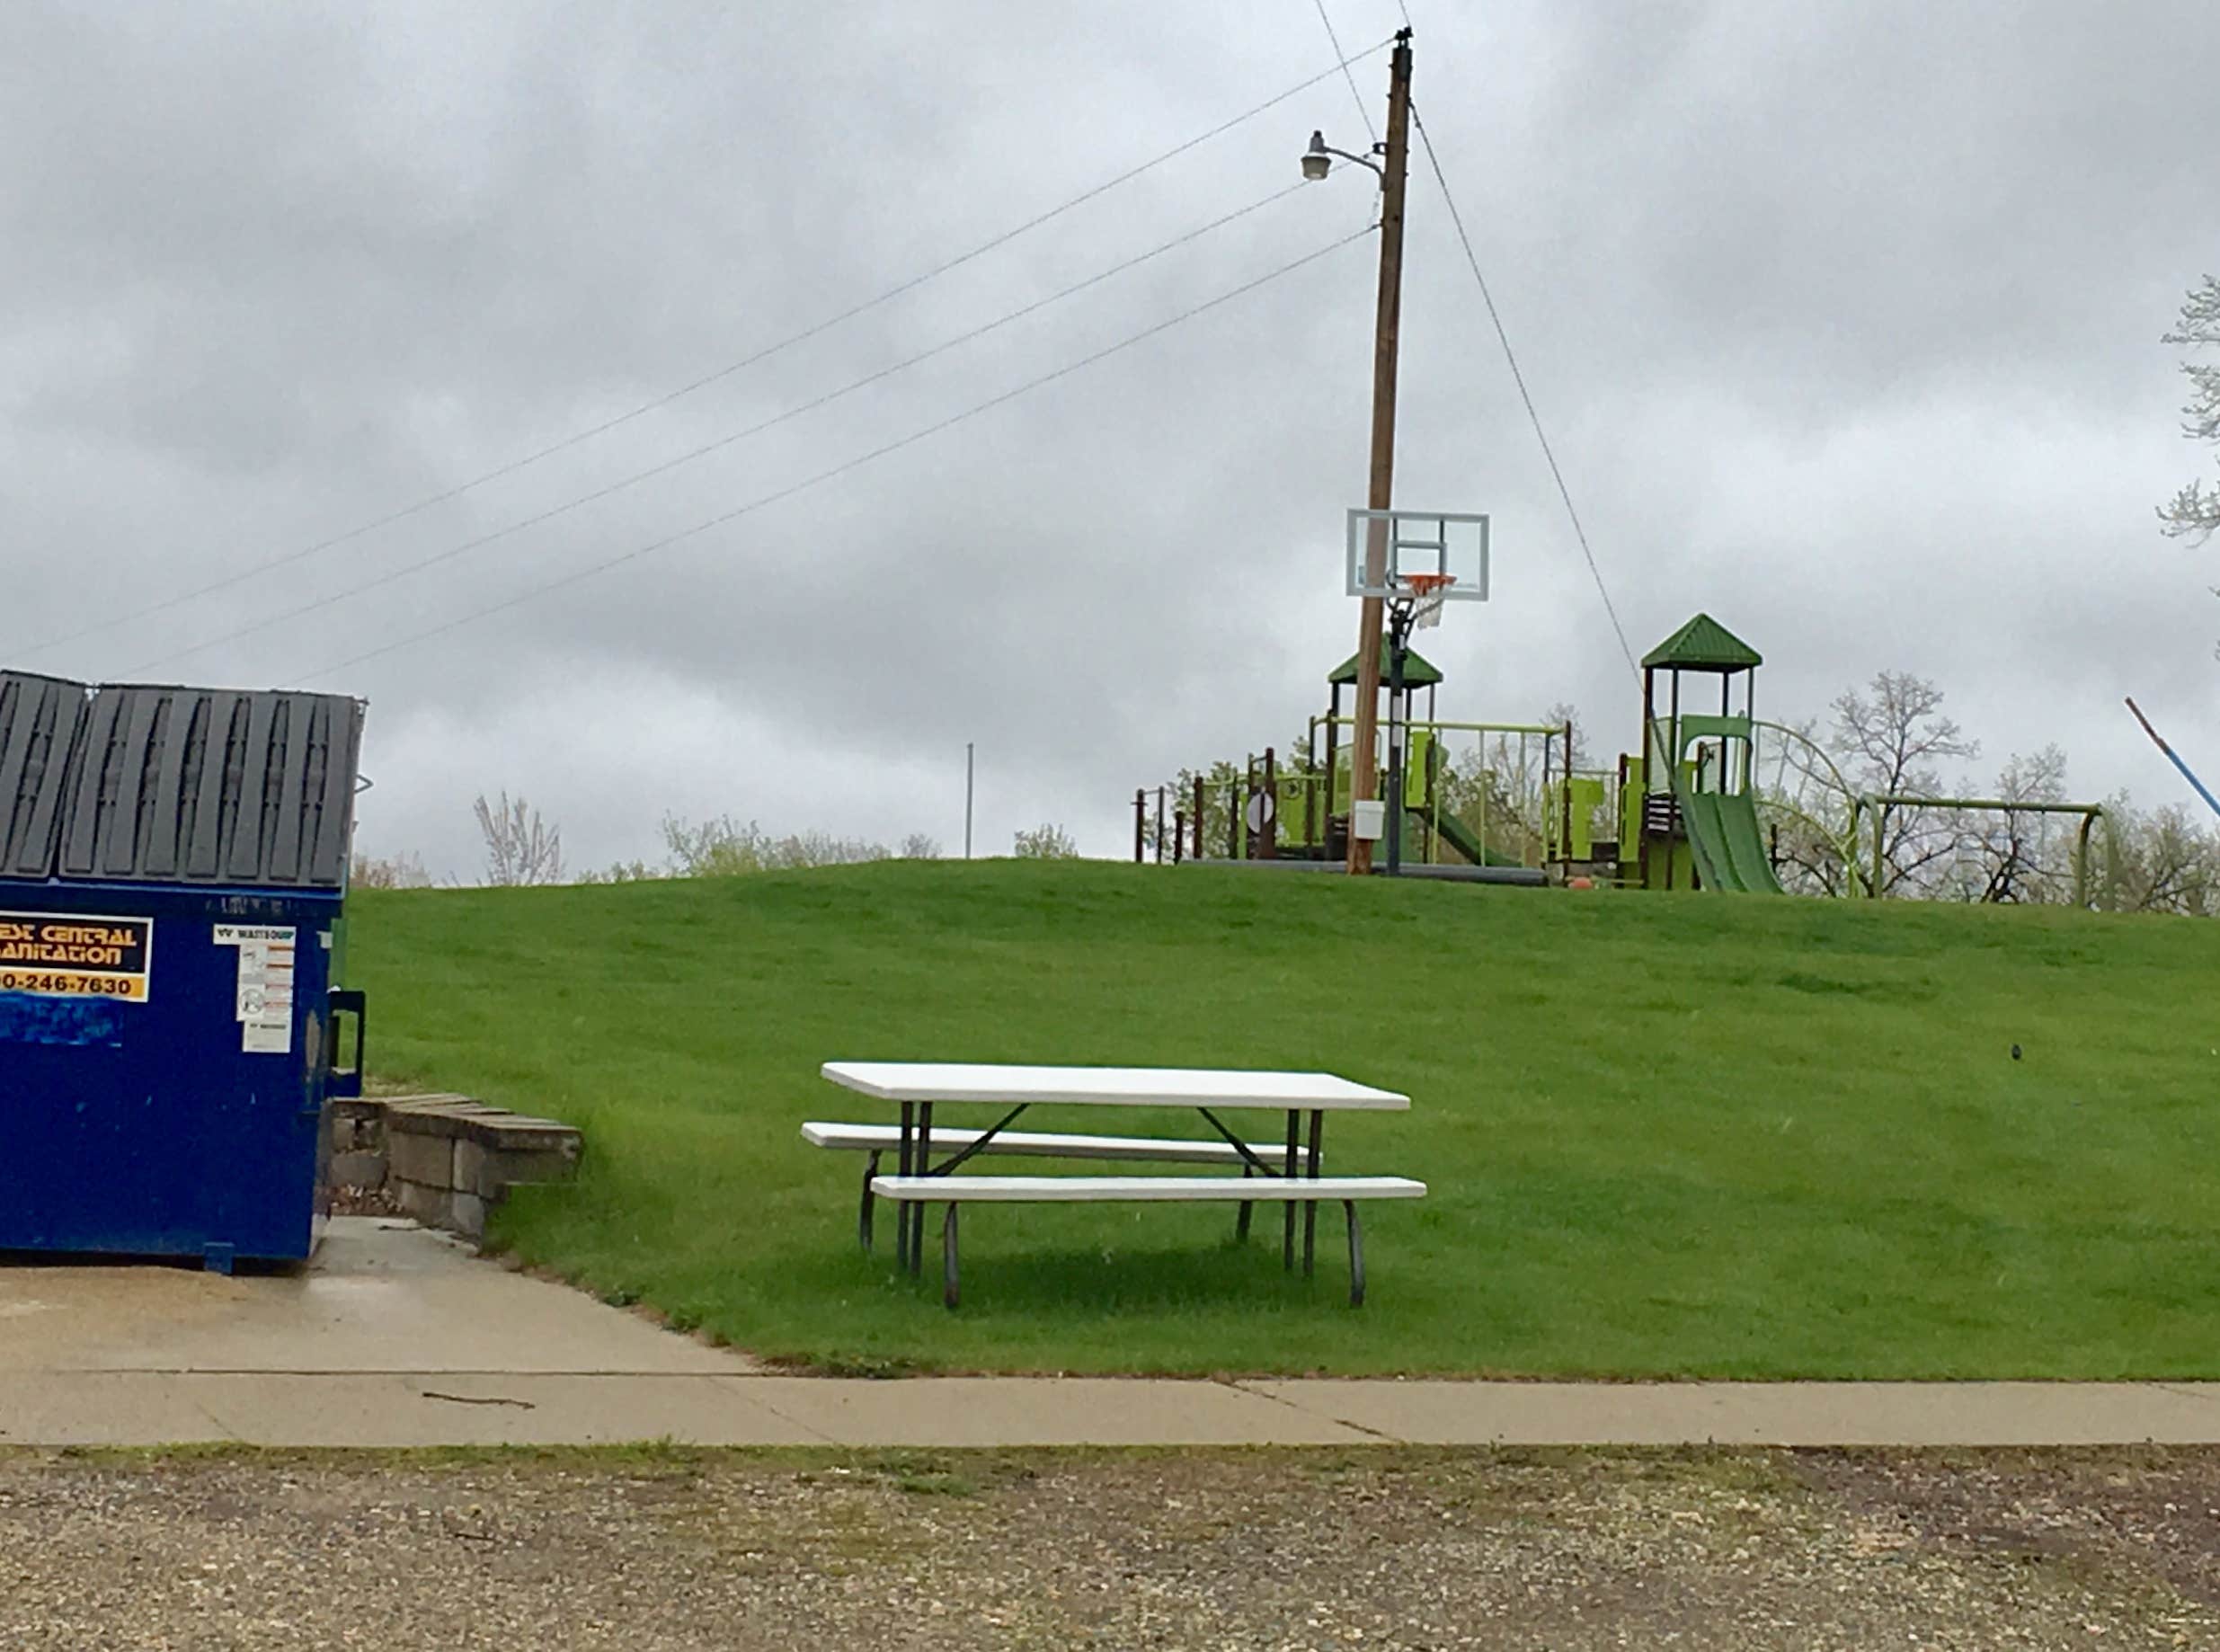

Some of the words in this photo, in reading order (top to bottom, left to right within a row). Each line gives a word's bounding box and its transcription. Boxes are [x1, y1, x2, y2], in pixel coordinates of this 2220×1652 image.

[0, 923, 35, 941] EST
[40, 925, 138, 946] CENTRAL
[0, 941, 122, 965] ANITATION
[0, 973, 132, 995] 0-246-7630
